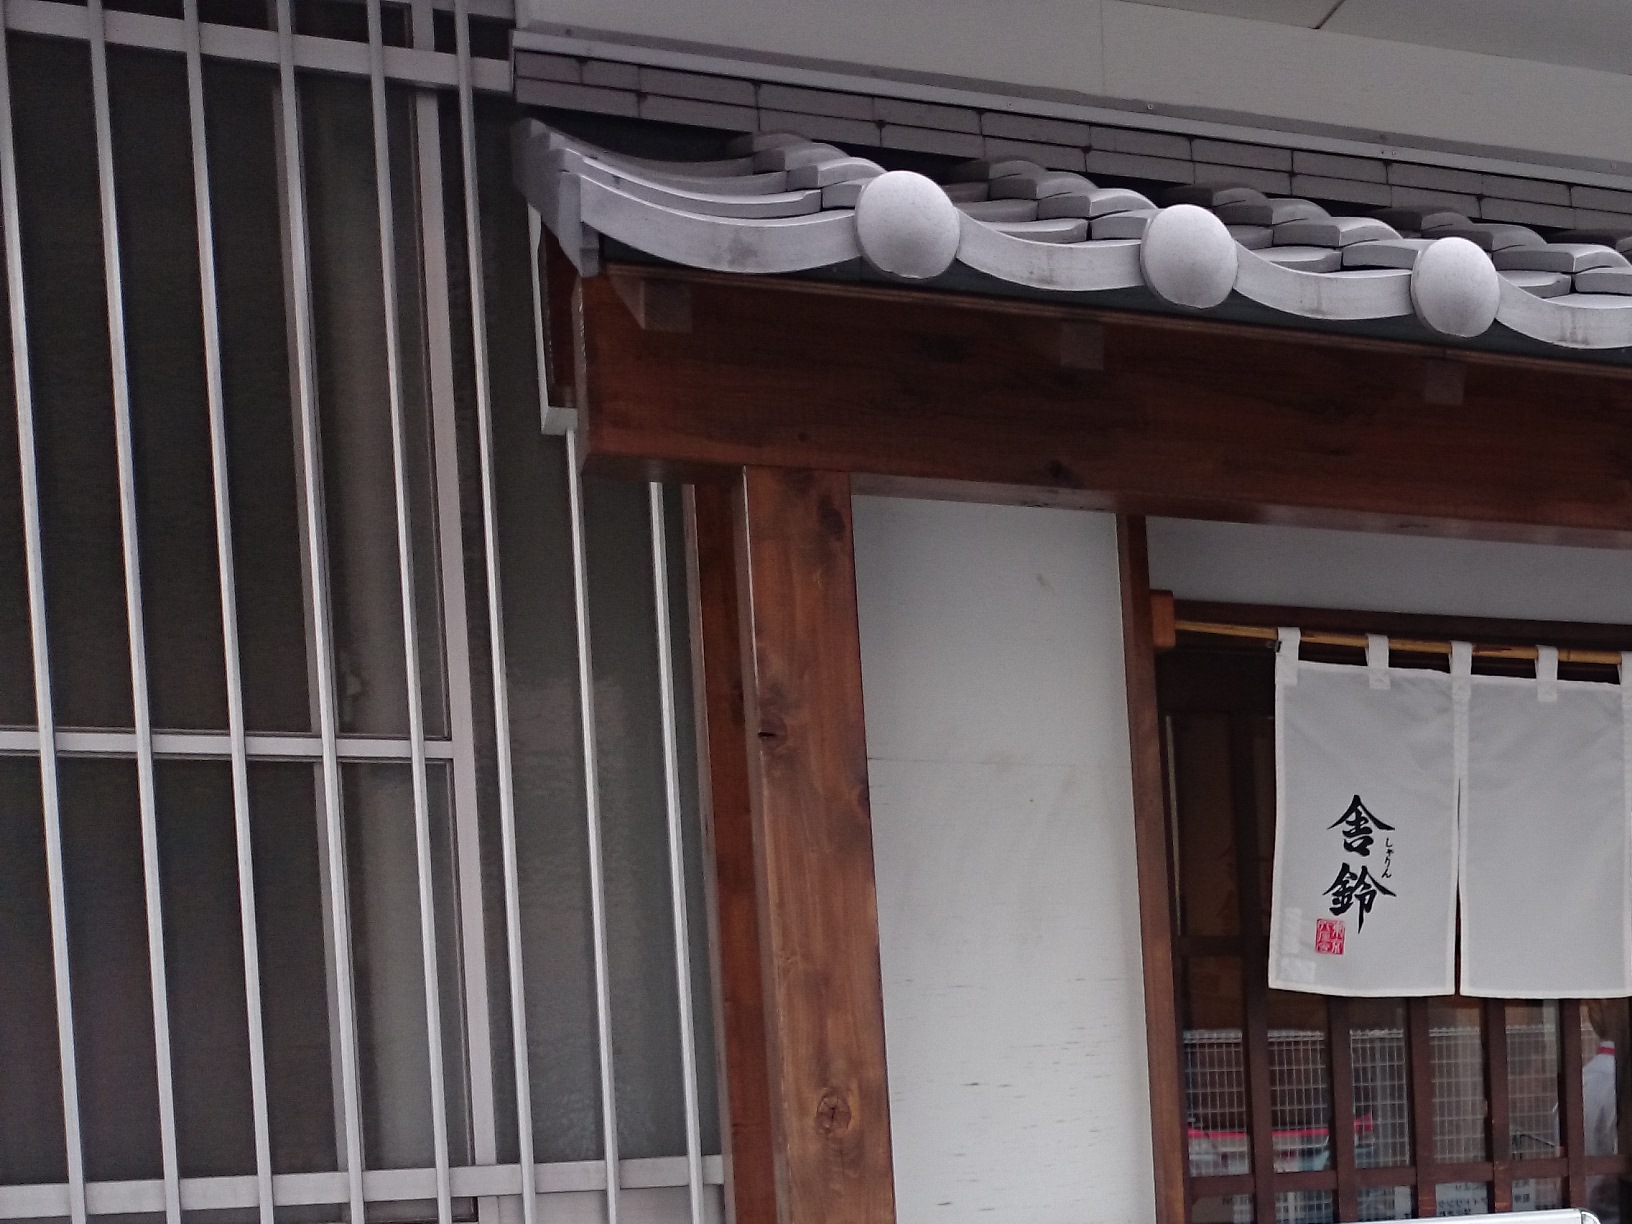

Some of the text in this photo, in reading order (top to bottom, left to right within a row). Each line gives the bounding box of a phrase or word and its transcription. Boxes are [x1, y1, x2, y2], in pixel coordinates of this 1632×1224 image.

[1322, 794, 1397, 934] 舎鈴
[1382, 837, 1395, 879] しゃりん
